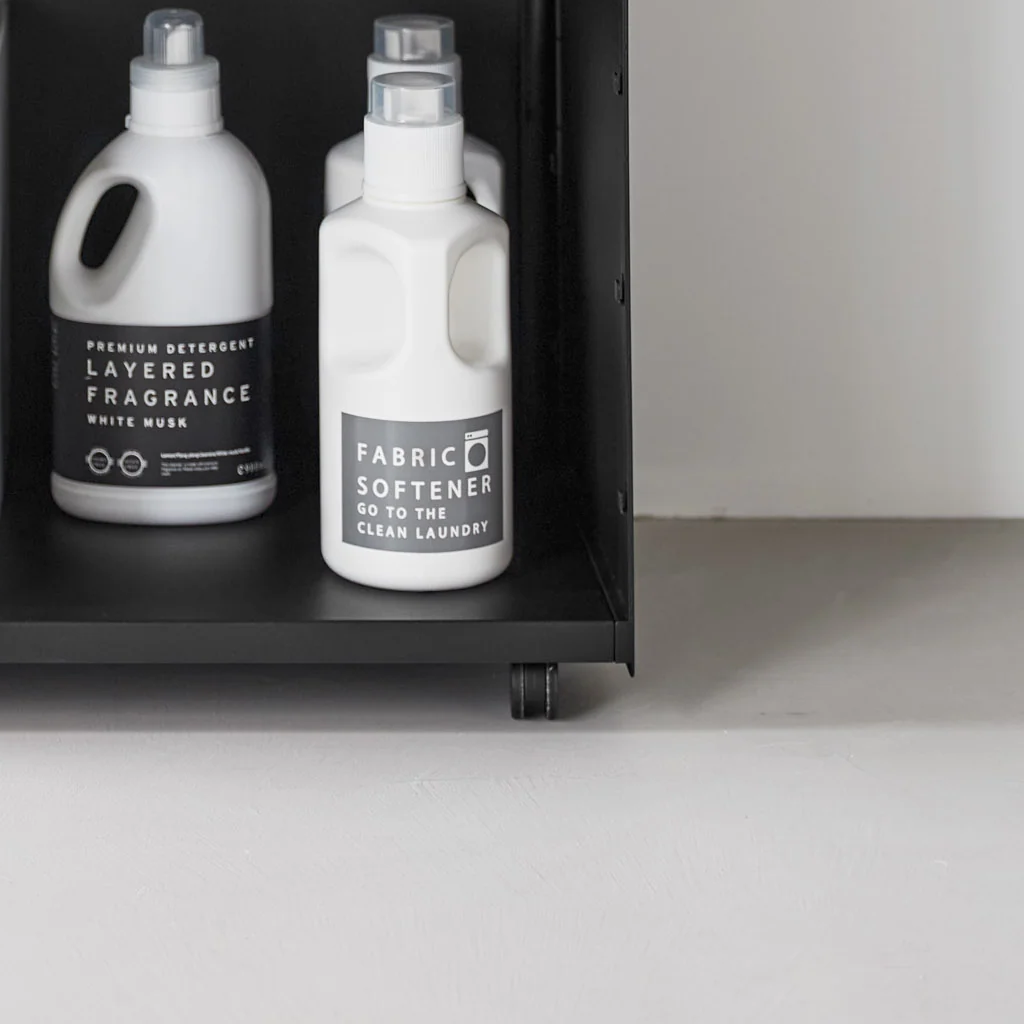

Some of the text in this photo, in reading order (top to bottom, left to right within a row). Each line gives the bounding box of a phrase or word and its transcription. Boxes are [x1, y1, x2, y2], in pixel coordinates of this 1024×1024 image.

[86, 336, 255, 354] PREMIUM DETERGENT
[86, 358, 215, 379] LAYERED
[86, 384, 251, 407] FRAGRANCE
[86, 414, 188, 428] WHITE MUSK
[357, 442, 456, 467] FABRIC
[357, 474, 492, 500] SOFTENER
[357, 502, 446, 520] GO TO THE
[357, 520, 488, 540] CLEAN LAUNDRY
